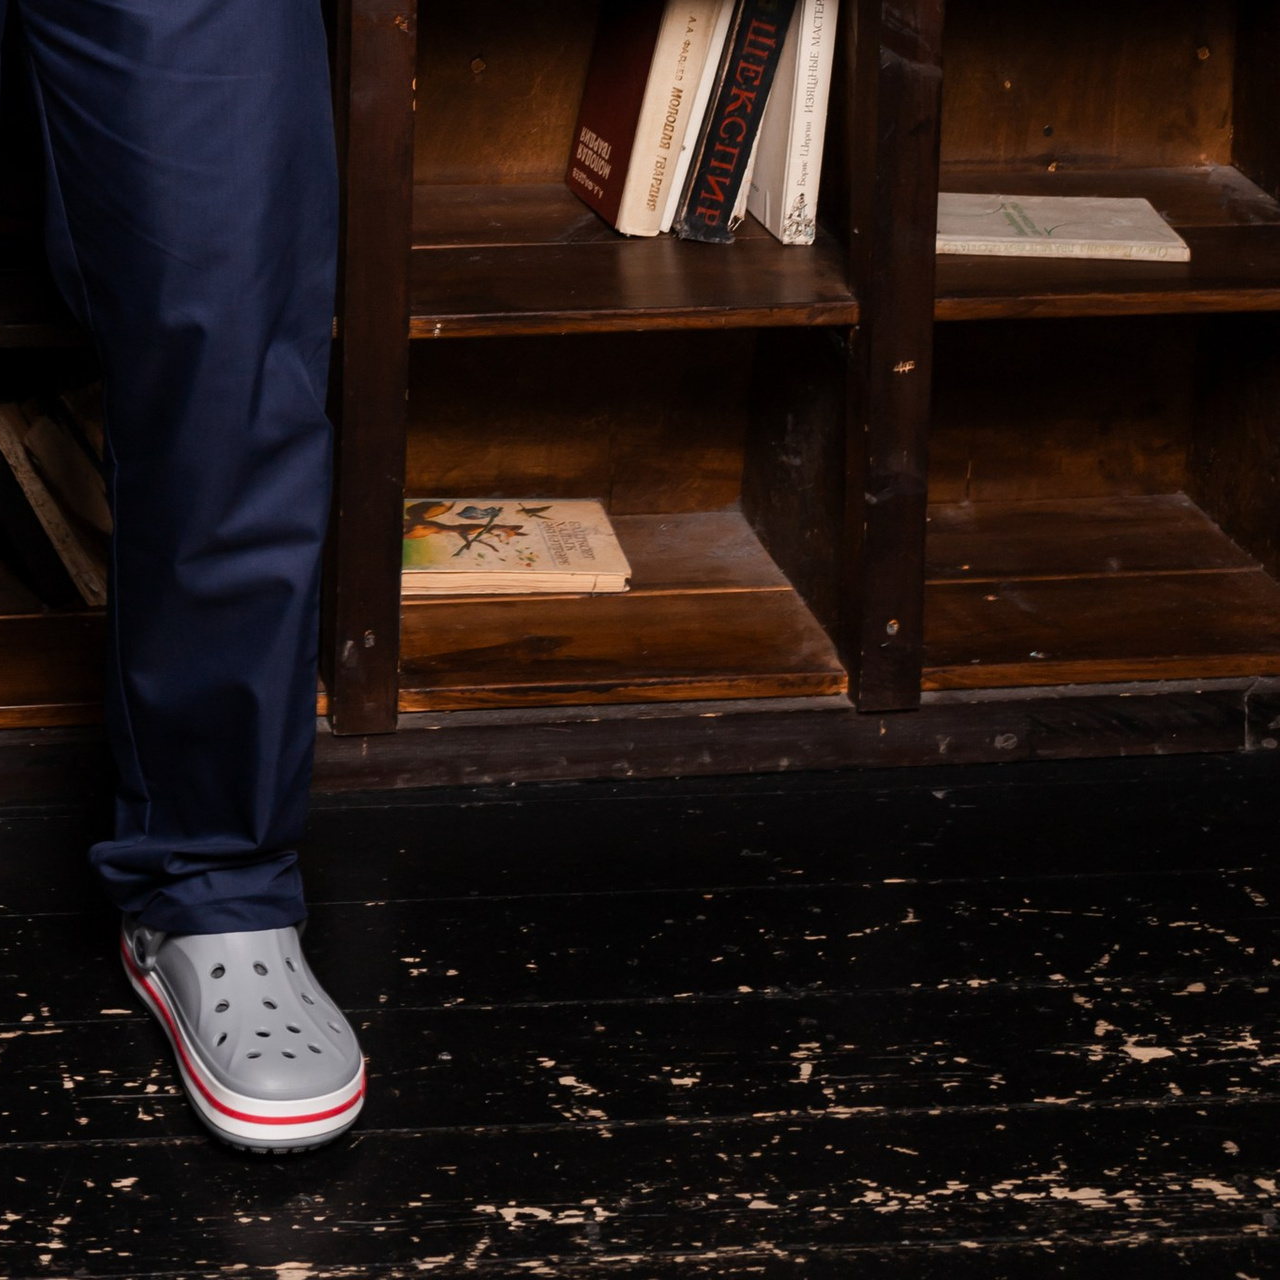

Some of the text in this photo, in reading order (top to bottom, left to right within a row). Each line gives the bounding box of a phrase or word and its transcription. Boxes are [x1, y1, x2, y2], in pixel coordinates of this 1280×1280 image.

[802, 50, 821, 113] ИЗЯЩНЫЕ
[576, 125, 611, 158] ГВАРДИЯ
[693, 16, 776, 228] ШЕКСПИР
[572, 141, 612, 179] МОЛОДАЯ
[643, 85, 683, 213] МОЛОДАЯ ГВАРДИЯ
[796, 159, 809, 187] Борис
